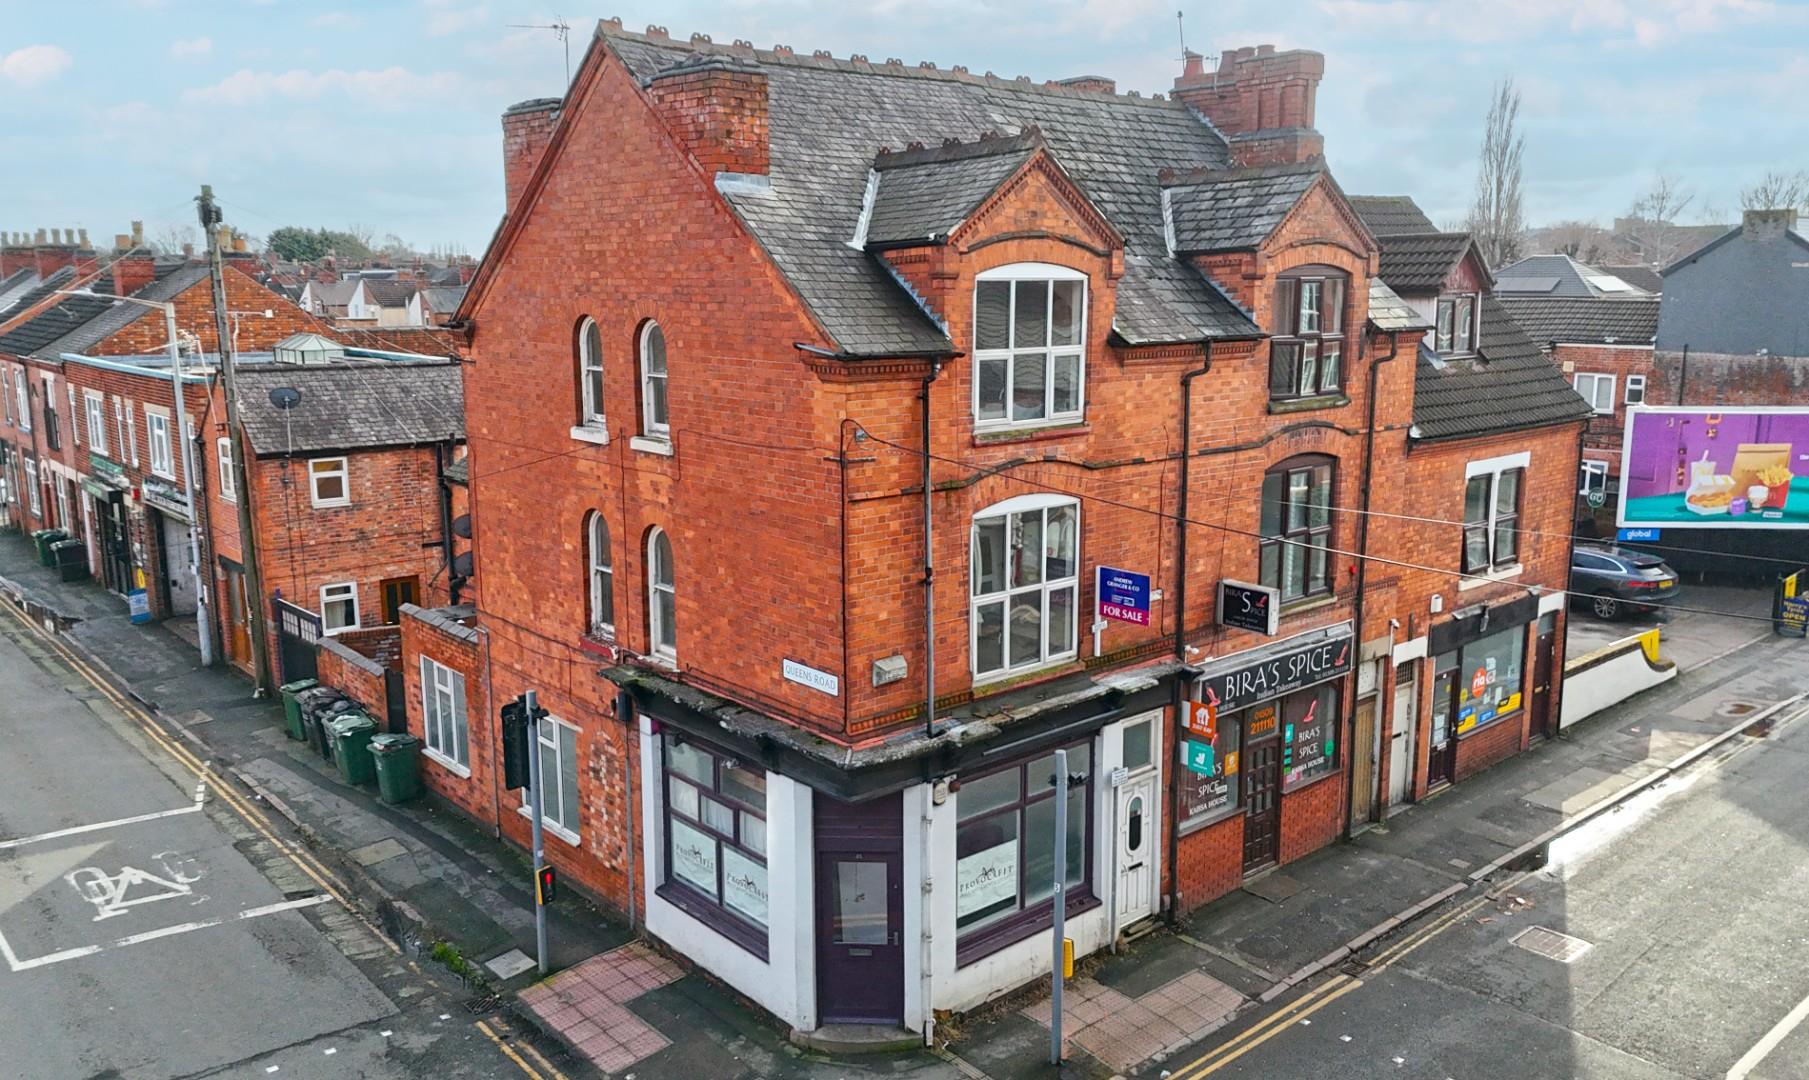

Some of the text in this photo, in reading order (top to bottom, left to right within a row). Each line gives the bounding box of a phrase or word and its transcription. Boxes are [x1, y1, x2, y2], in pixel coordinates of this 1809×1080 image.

[1626, 529, 1652, 541] global
[1103, 604, 1143, 623] FOR SALE
[1782, 611, 1807, 621] OPEN
[785, 664, 836, 690] QUEENS ROAD
[1225, 645, 1332, 701] BIRA'S SPICE
[1473, 672, 1486, 689] ria
[1256, 680, 1303, 700] Indian Takeaway
[1250, 716, 1277, 735] 211110
[1298, 742, 1319, 759] SPICE
[1307, 755, 1325, 768] HOUSE
[1207, 795, 1228, 809] HOUSE
